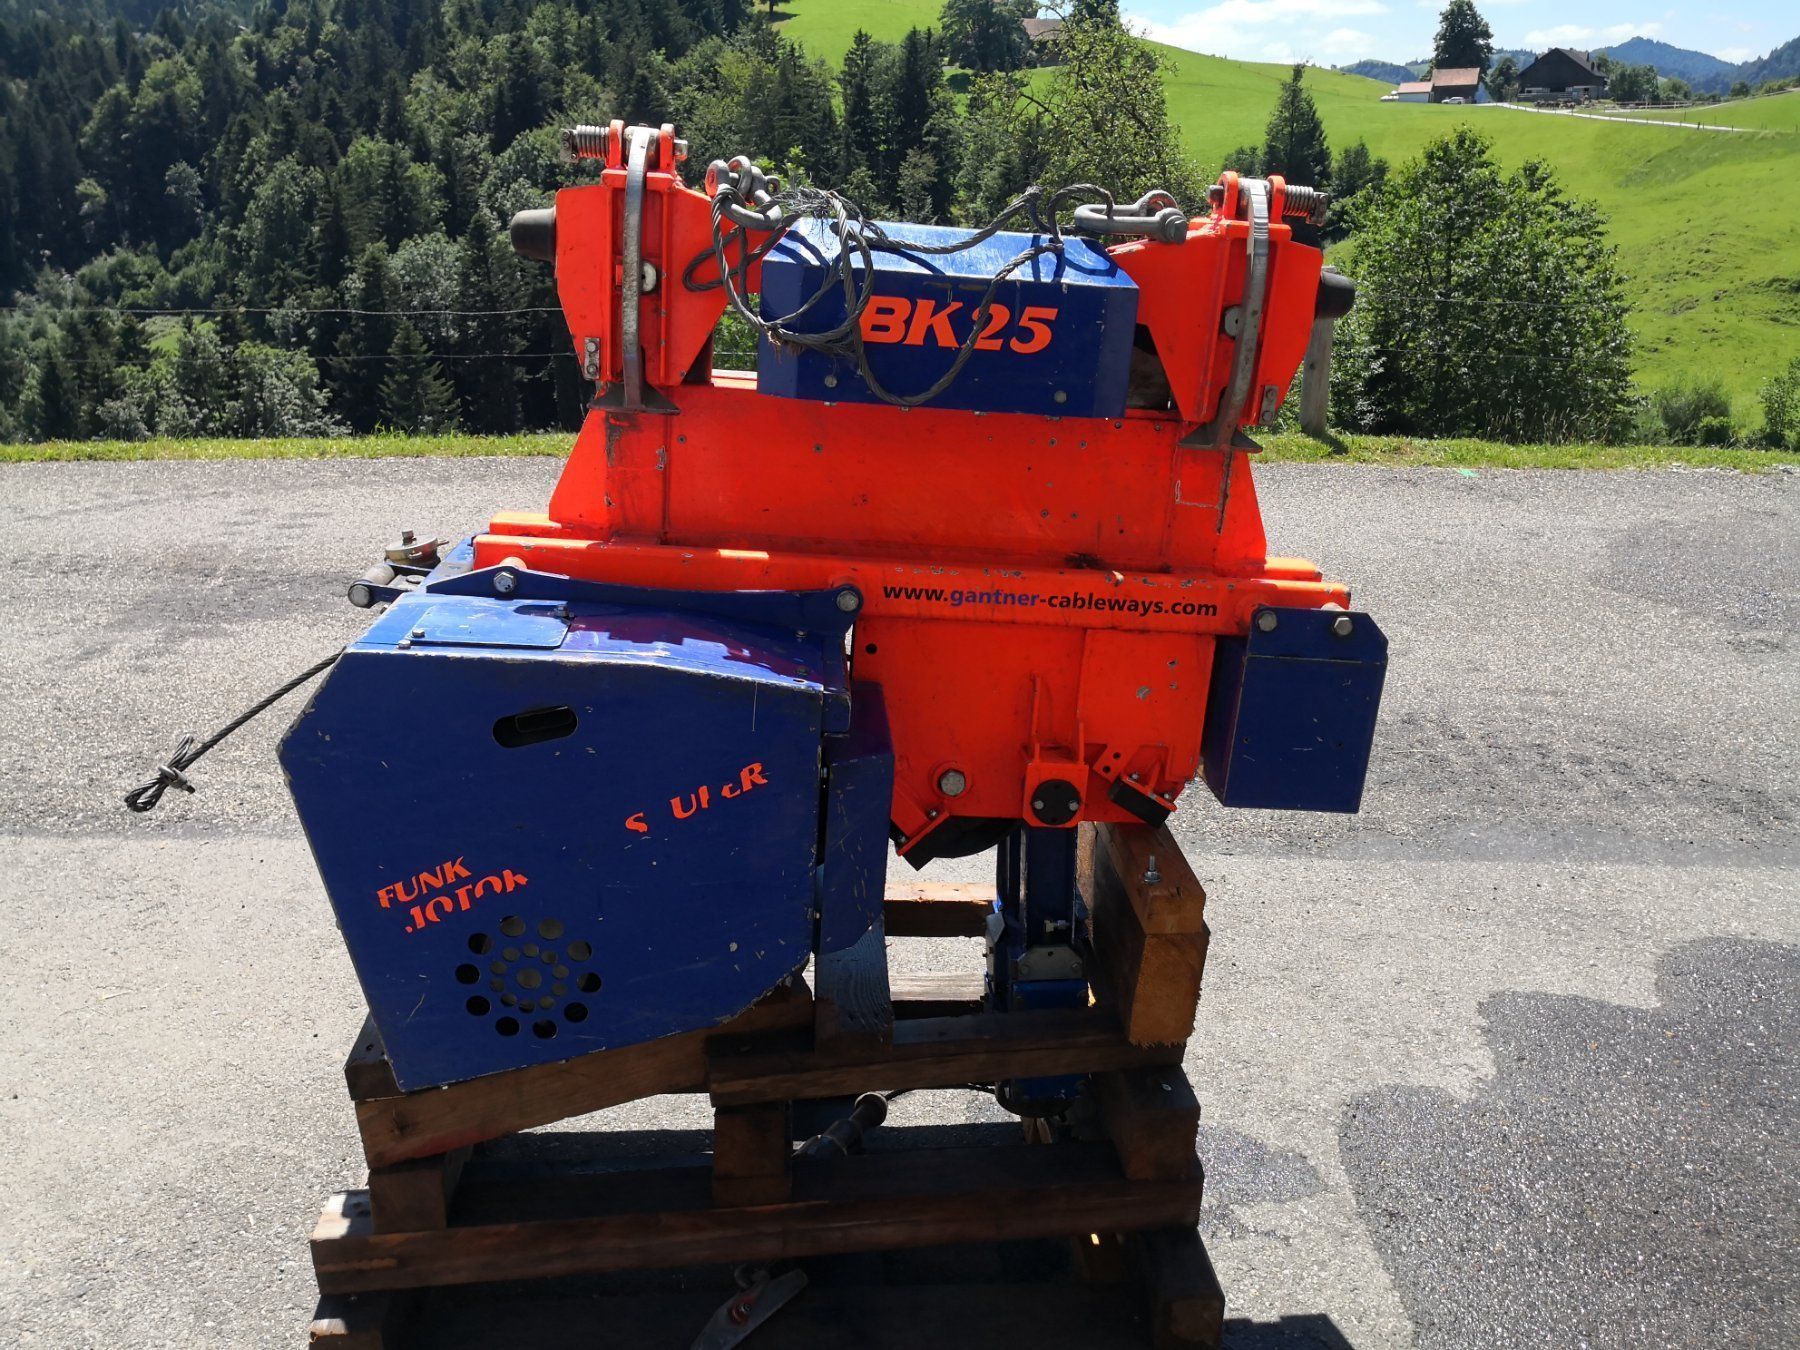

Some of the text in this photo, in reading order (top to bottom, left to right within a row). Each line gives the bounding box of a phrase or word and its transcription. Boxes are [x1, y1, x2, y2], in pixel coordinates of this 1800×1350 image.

[858, 295, 1059, 354] BK 25
[883, 585, 1218, 617] www.gantner-cableways.com
[376, 856, 472, 909] FUNK
